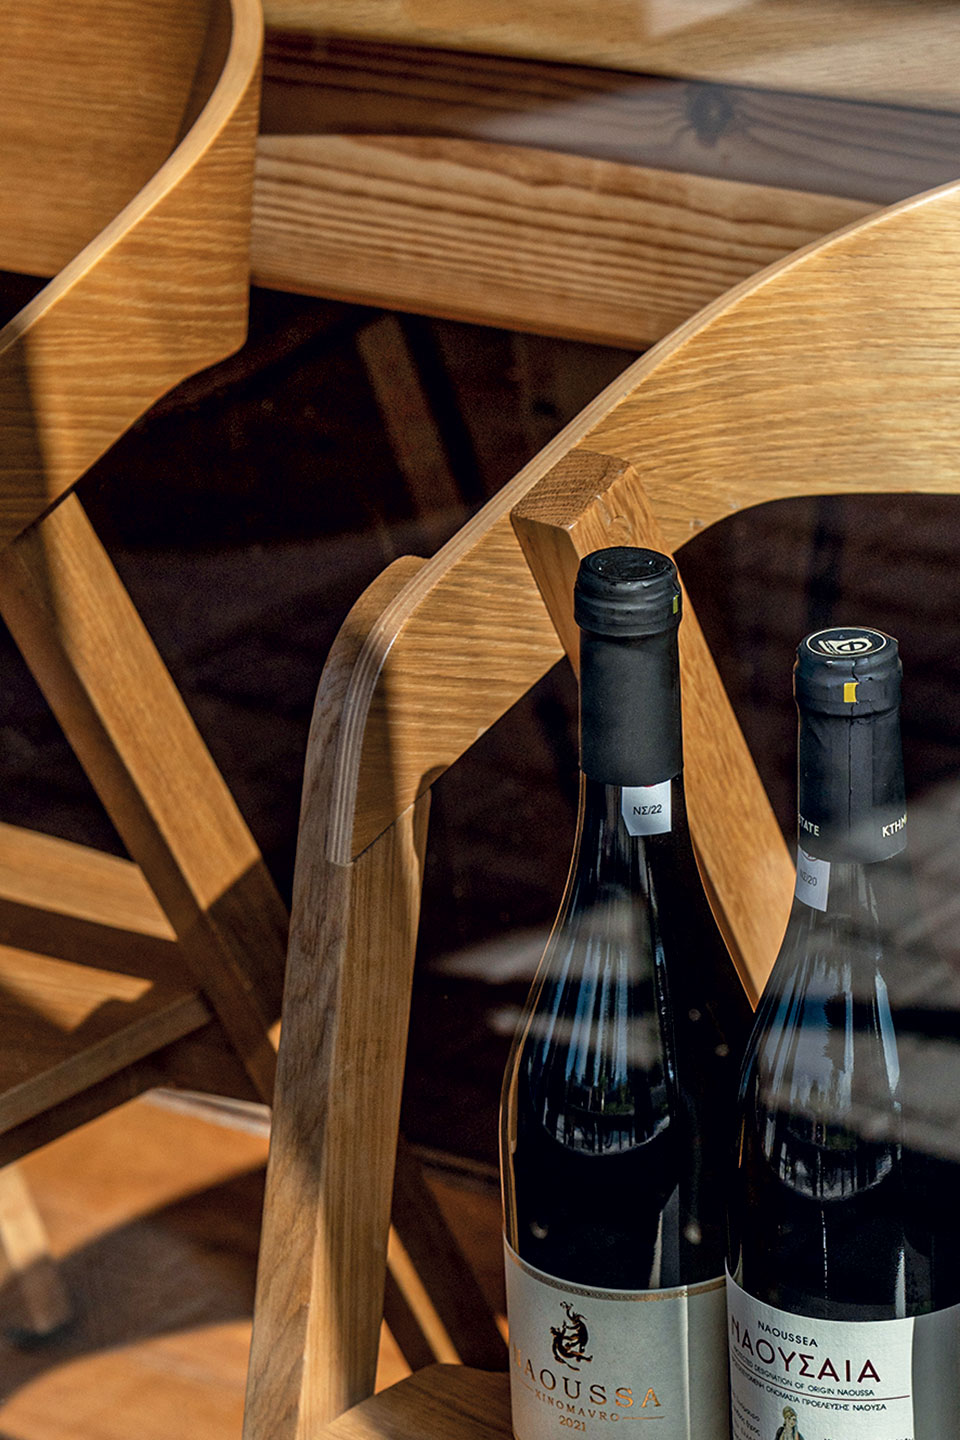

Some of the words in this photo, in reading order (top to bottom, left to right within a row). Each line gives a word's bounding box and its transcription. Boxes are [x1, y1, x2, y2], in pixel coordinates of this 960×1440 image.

[633, 804, 662, 815] ΝΣ/22
[758, 1320, 818, 1348] NAOUSSEA
[731, 1314, 881, 1383] ΝΑΟΥΣΑΙΑ
[807, 1384, 835, 1395] ORIGIN
[837, 1388, 875, 1397] NAOUSSA
[852, 1403, 888, 1411] ΝΑΟΥΣΑ
[559, 1414, 587, 1432] 2021
